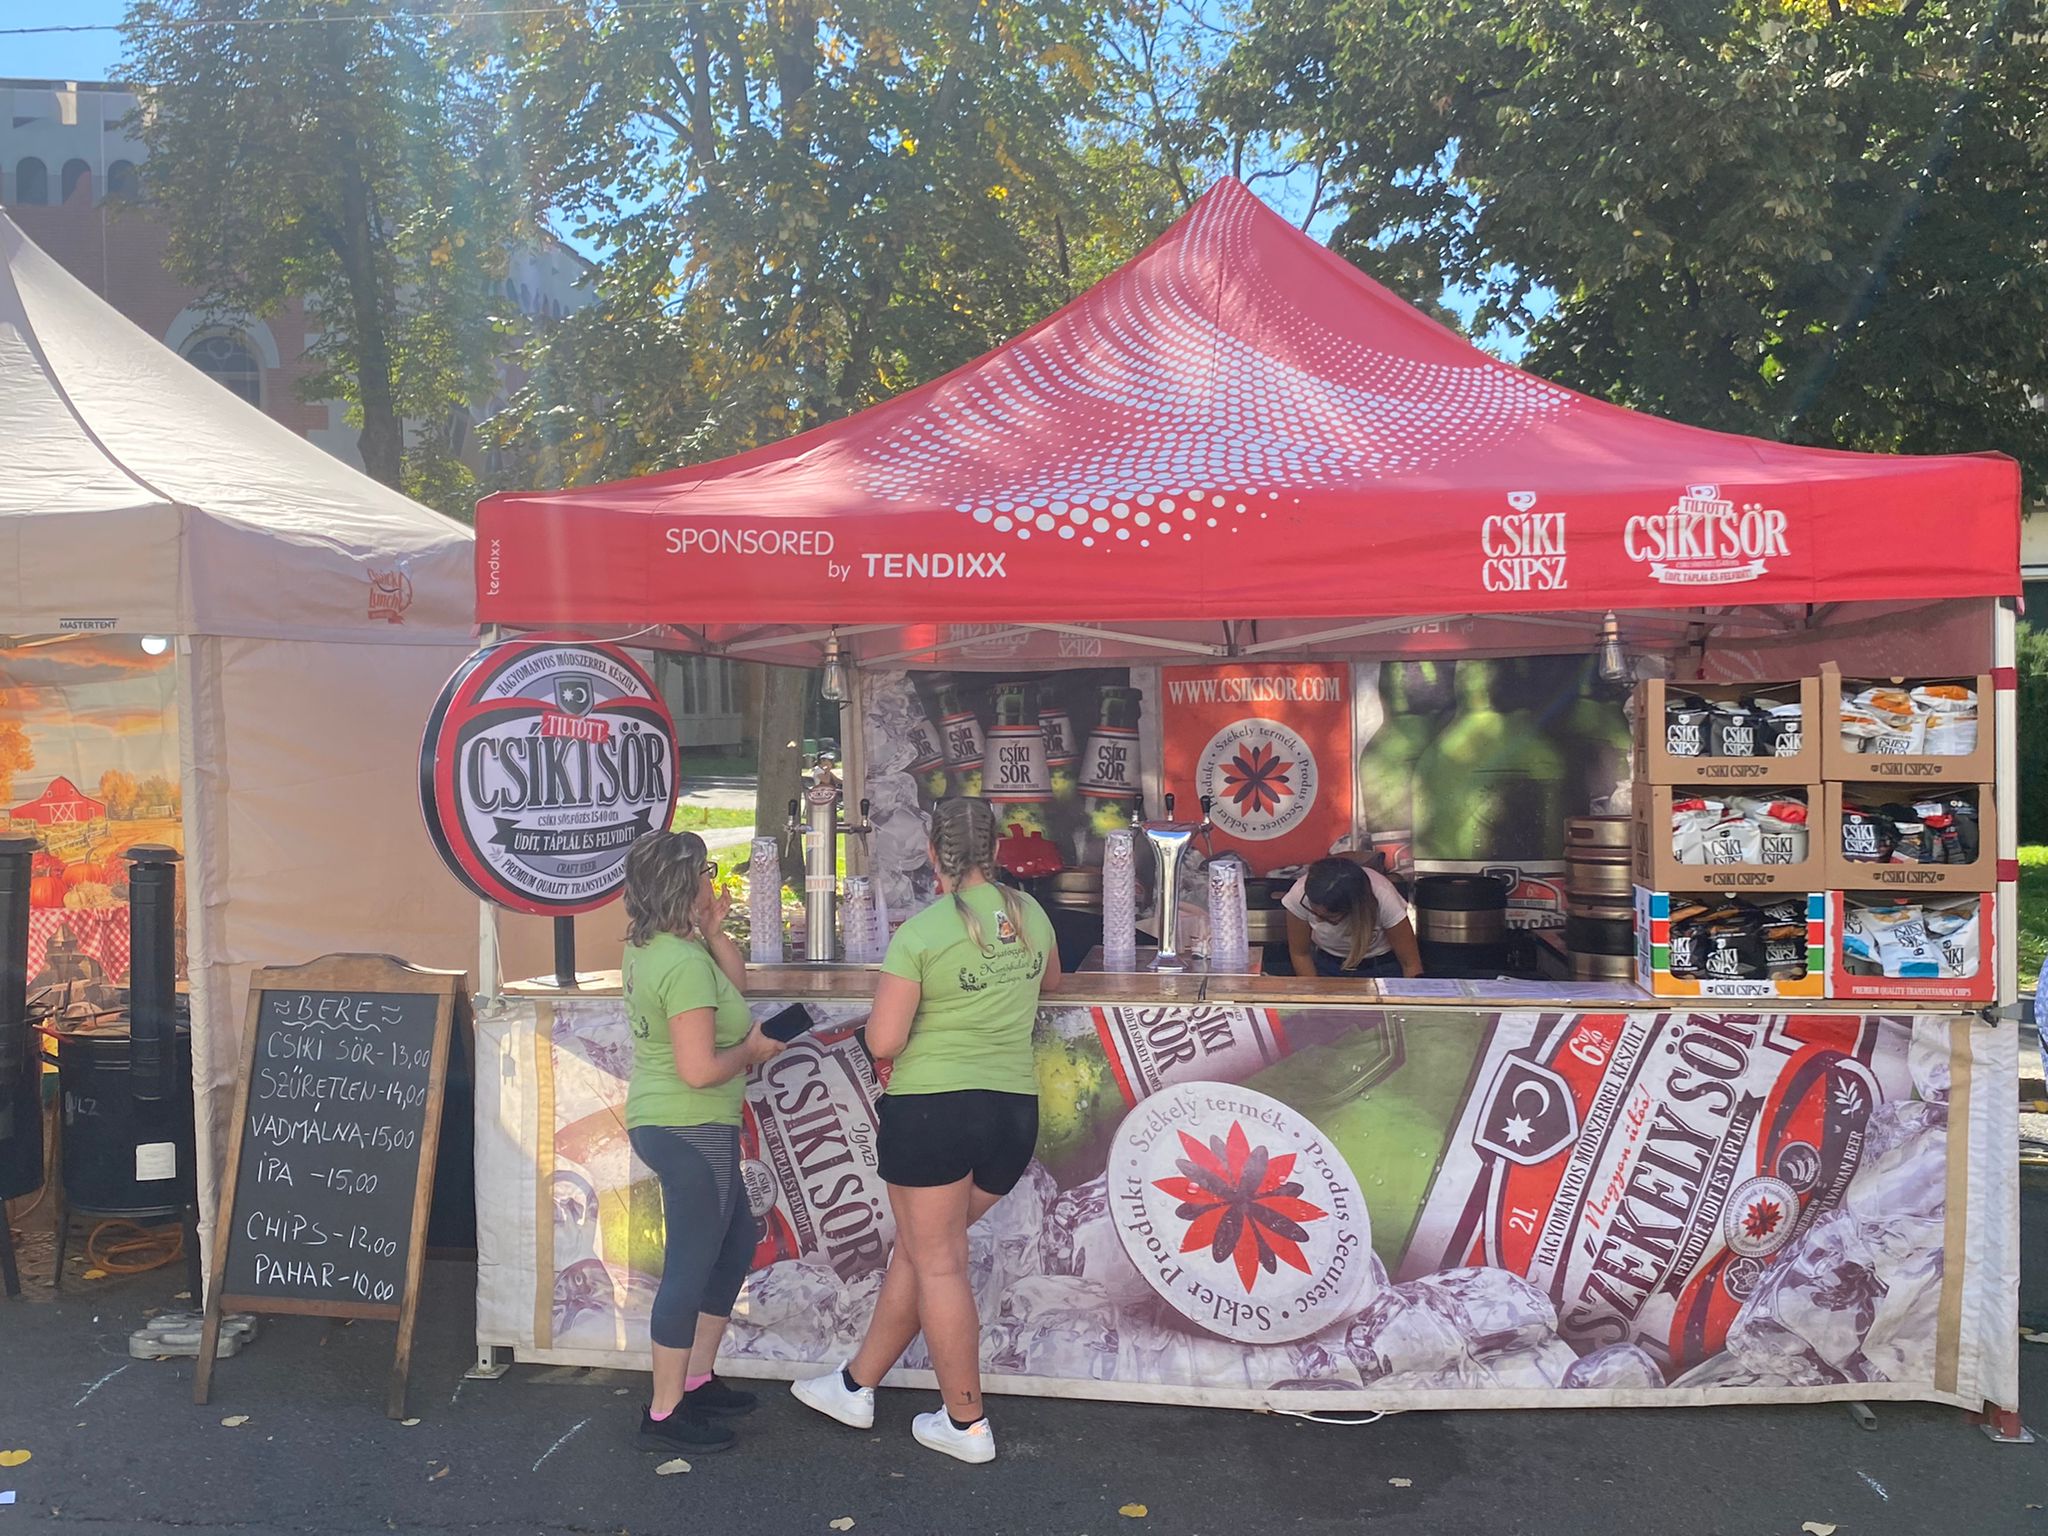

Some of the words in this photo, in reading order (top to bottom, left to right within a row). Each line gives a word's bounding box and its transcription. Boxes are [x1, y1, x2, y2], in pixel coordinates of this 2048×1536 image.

[1684, 499, 1729, 516] TILTOTT
[665, 527, 834, 557] SPONSORED
[1719, 503, 1790, 560] SÖR
[486, 539, 501, 596] tendixx
[828, 559, 851, 583] by
[861, 552, 1007, 579] TENDIXX
[1482, 556, 1568, 592] CSIPSZ
[60, 621, 116, 630] MASTERTENT
[496, 655, 557, 697] HAGYOMÁNYOS
[556, 652, 608, 674] MÓDSZERREL
[1168, 676, 1341, 704] WWW.CSIKISOR.COM
[547, 713, 606, 742] TILTOTT
[1215, 725, 1255, 752] Székely
[1259, 725, 1297, 752] termék
[1667, 741, 1699, 755] CSIPSZ
[1723, 743, 1754, 756] CSIPSZ
[467, 721, 593, 812] CSÍKI
[597, 721, 668, 807] SÖR
[1299, 758, 1313, 800] Produs
[1730, 765, 1760, 777] CSIPSZ
[1904, 763, 1935, 776] CSIPSZ
[1260, 802, 1304, 832] Secuiesc
[543, 832, 581, 852] TÁPLÁL
[582, 831, 595, 850] ÉS
[596, 826, 636, 847] FELVIDÍT!
[1845, 839, 1877, 853] CSIPSZ
[501, 858, 538, 888] PREMIUM
[535, 879, 570, 895] QUALITY
[1737, 873, 1767, 885] CSIPSZ
[1906, 871, 1937, 884] CSIPSZ
[1736, 985, 1763, 995] CSIPSZ
[297, 995, 373, 1022] BERE
[1569, 1026, 1607, 1067] 6%
[767, 1053, 855, 1180] CSÍKI
[1129, 1097, 1200, 1154] Székely
[1205, 1097, 1287, 1135] termék
[1538, 1163, 1587, 1267] HAGYOMÁNYOS
[1574, 1078, 1623, 1166] MÓDSZERREL
[1609, 1021, 1647, 1082] KÉSZÜLT
[1719, 1114, 1751, 1172] TÁPLÁL!
[1844, 1130, 1864, 1161] BEER
[1303, 1140, 1351, 1222] Produs
[1584, 1146, 1632, 1230] Nagyon
[1710, 1169, 1730, 1190] ÉS
[808, 1173, 889, 1284] SÖR
[1120, 1175, 1185, 1288] Produkt
[1508, 1207, 1539, 1236] 2L
[1560, 1101, 1720, 1343] SZÉKELY
[1673, 1220, 1714, 1277] FELVIDÍT,
[1295, 1229, 1359, 1314] Secuiesc
[1187, 1279, 1271, 1332] Sekler
